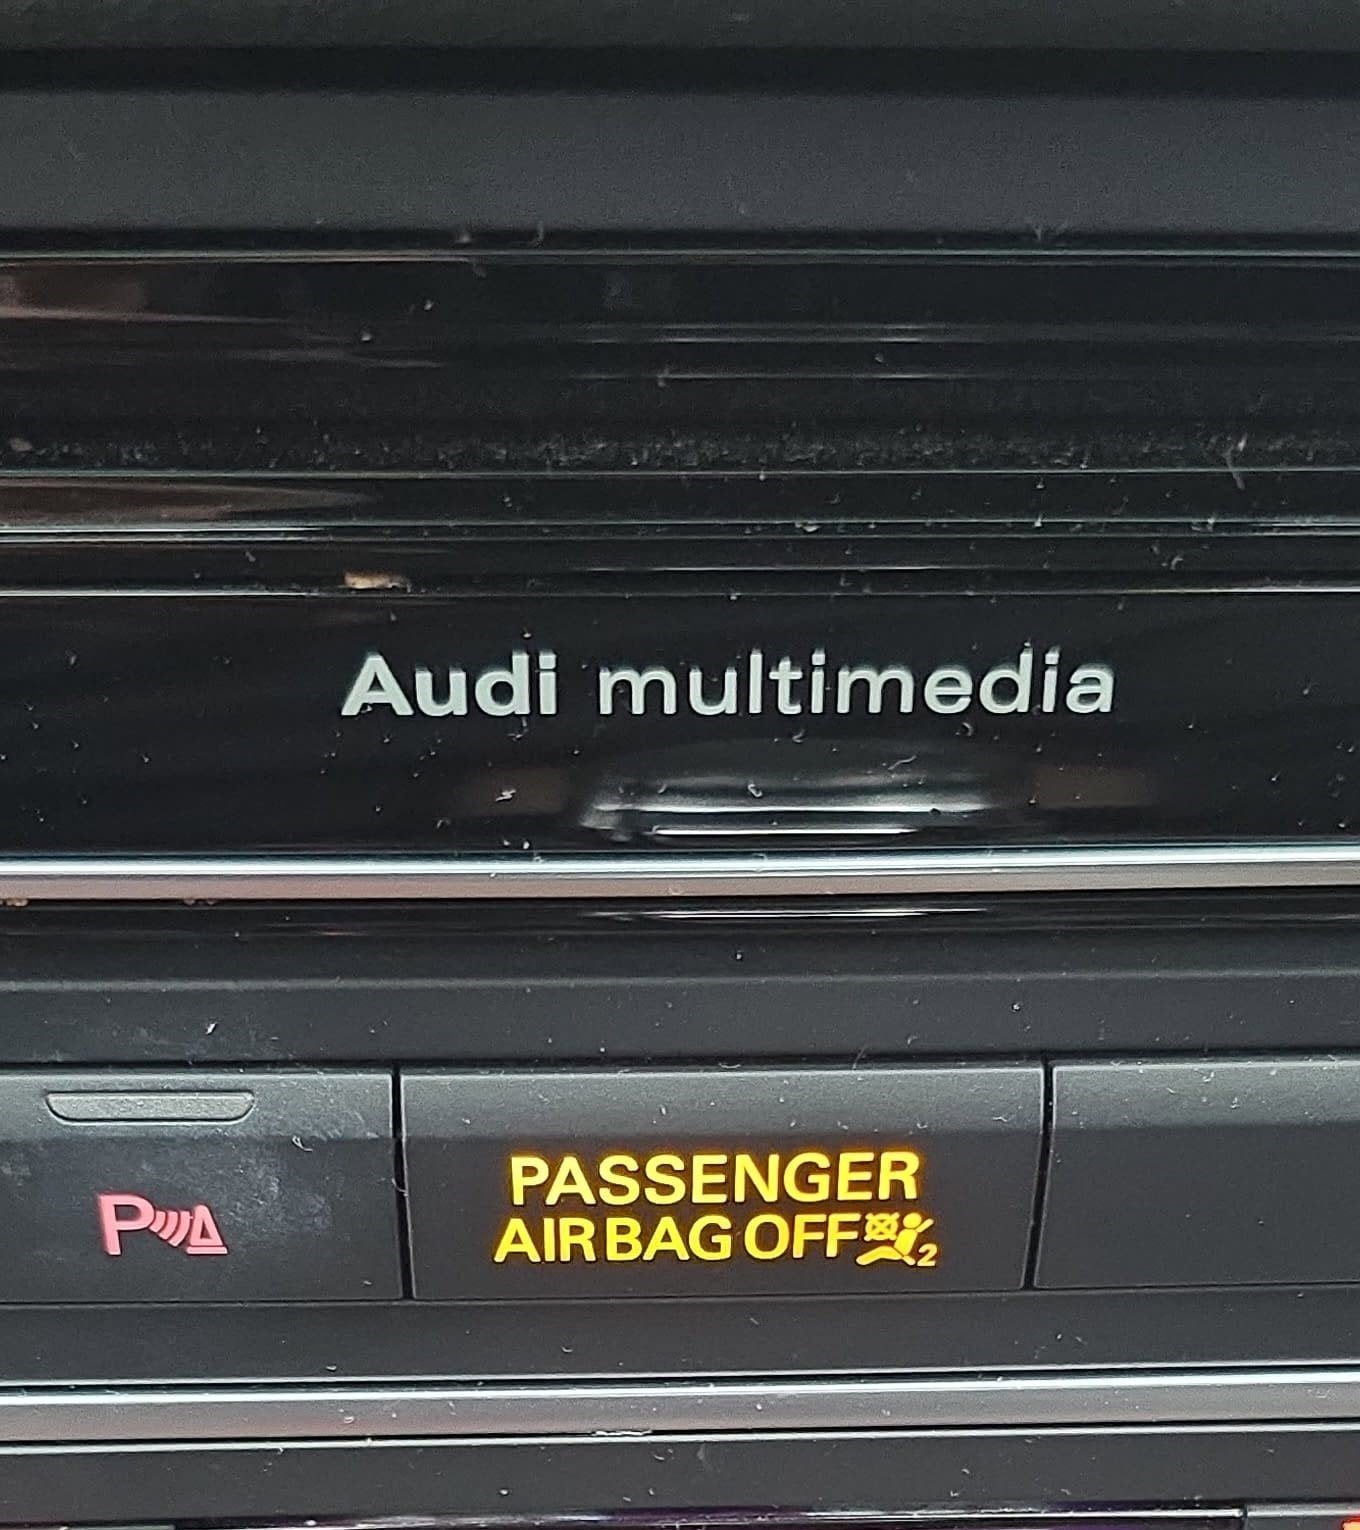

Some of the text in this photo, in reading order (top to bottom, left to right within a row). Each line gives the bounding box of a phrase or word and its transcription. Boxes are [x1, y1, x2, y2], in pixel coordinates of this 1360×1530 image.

[340, 646, 1116, 717] Audi multimedia
[509, 1150, 921, 1206] PASSENGER
[744, 1212, 862, 1260] OFF
